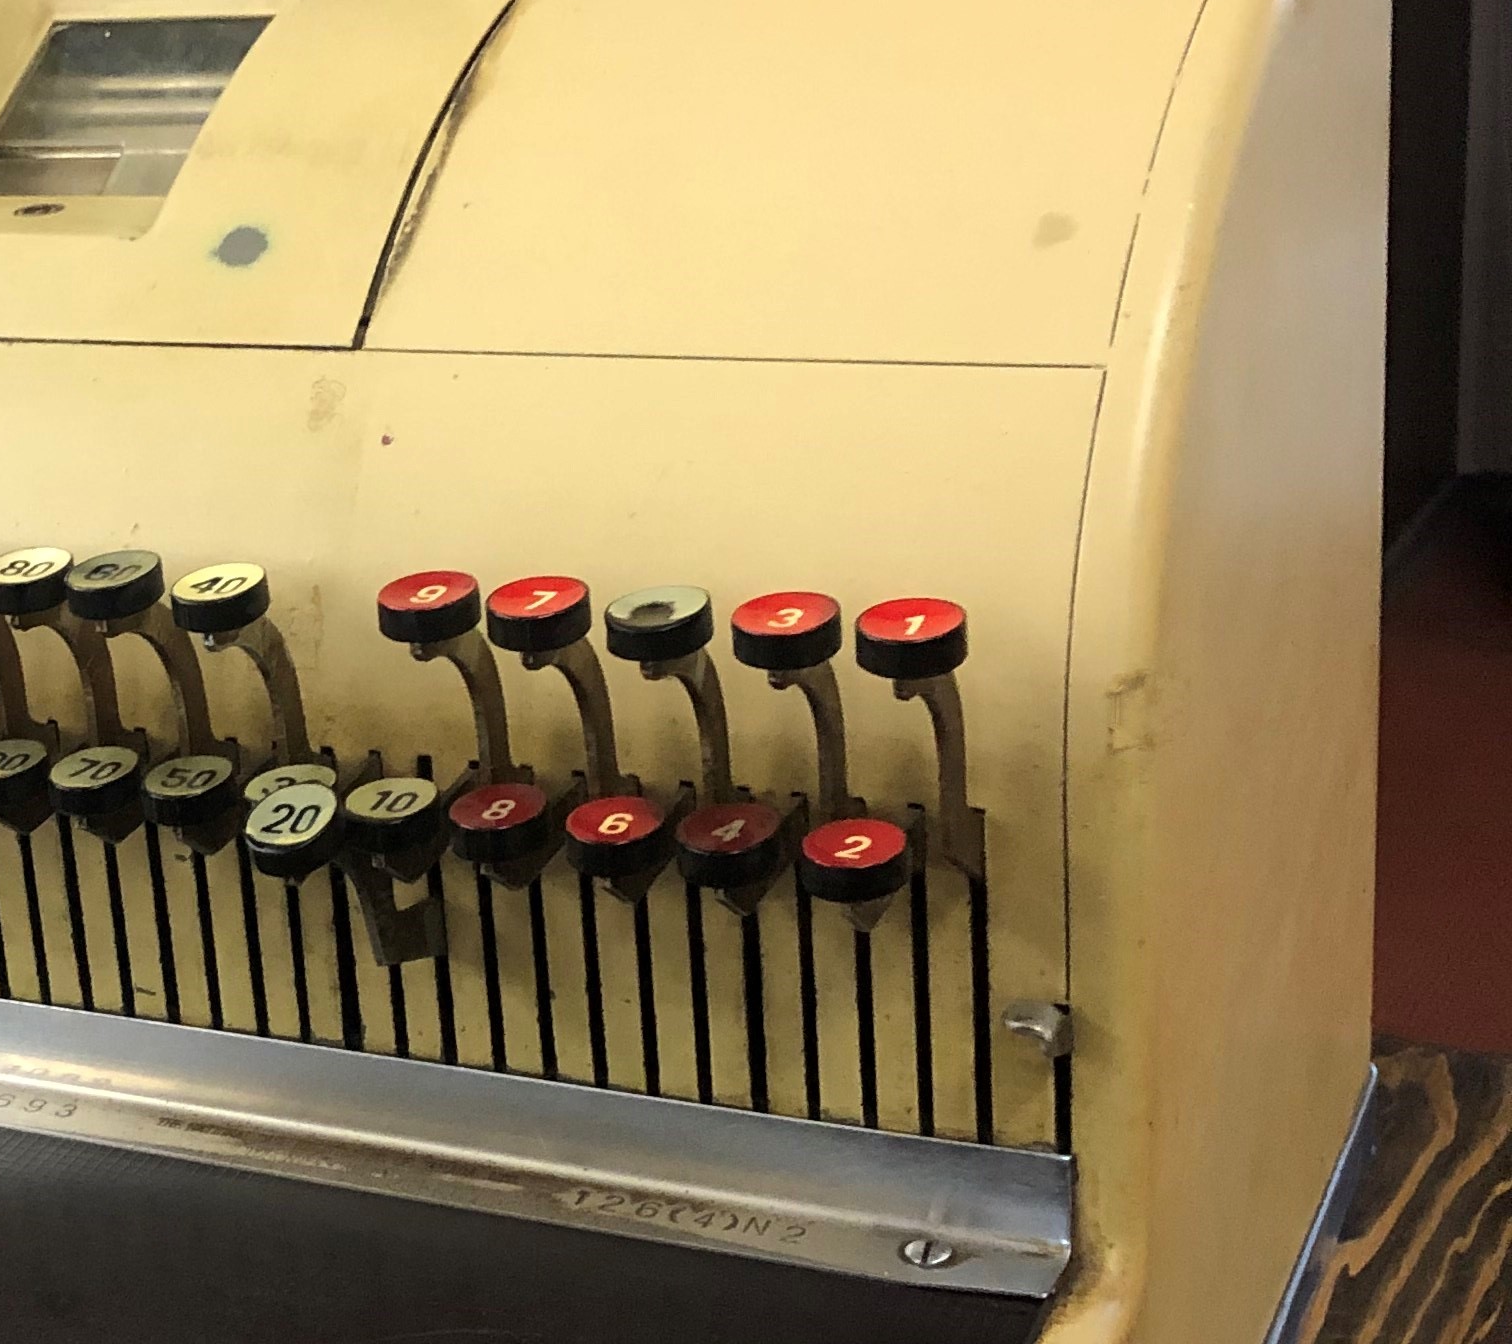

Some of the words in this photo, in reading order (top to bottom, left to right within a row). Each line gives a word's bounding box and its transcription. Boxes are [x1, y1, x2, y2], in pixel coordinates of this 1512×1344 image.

[0, 559, 55, 577] 80
[190, 576, 248, 594] 40
[408, 584, 447, 604] 9
[524, 590, 557, 610] 7
[766, 607, 805, 628] 3
[901, 615, 927, 636] 1
[67, 758, 121, 781] 70
[160, 767, 217, 789] 50
[370, 790, 420, 813] 10
[481, 798, 517, 821] 8
[261, 804, 321, 834] 20
[597, 812, 635, 834] 6
[710, 818, 747, 843] 4
[834, 834, 874, 860] 2
